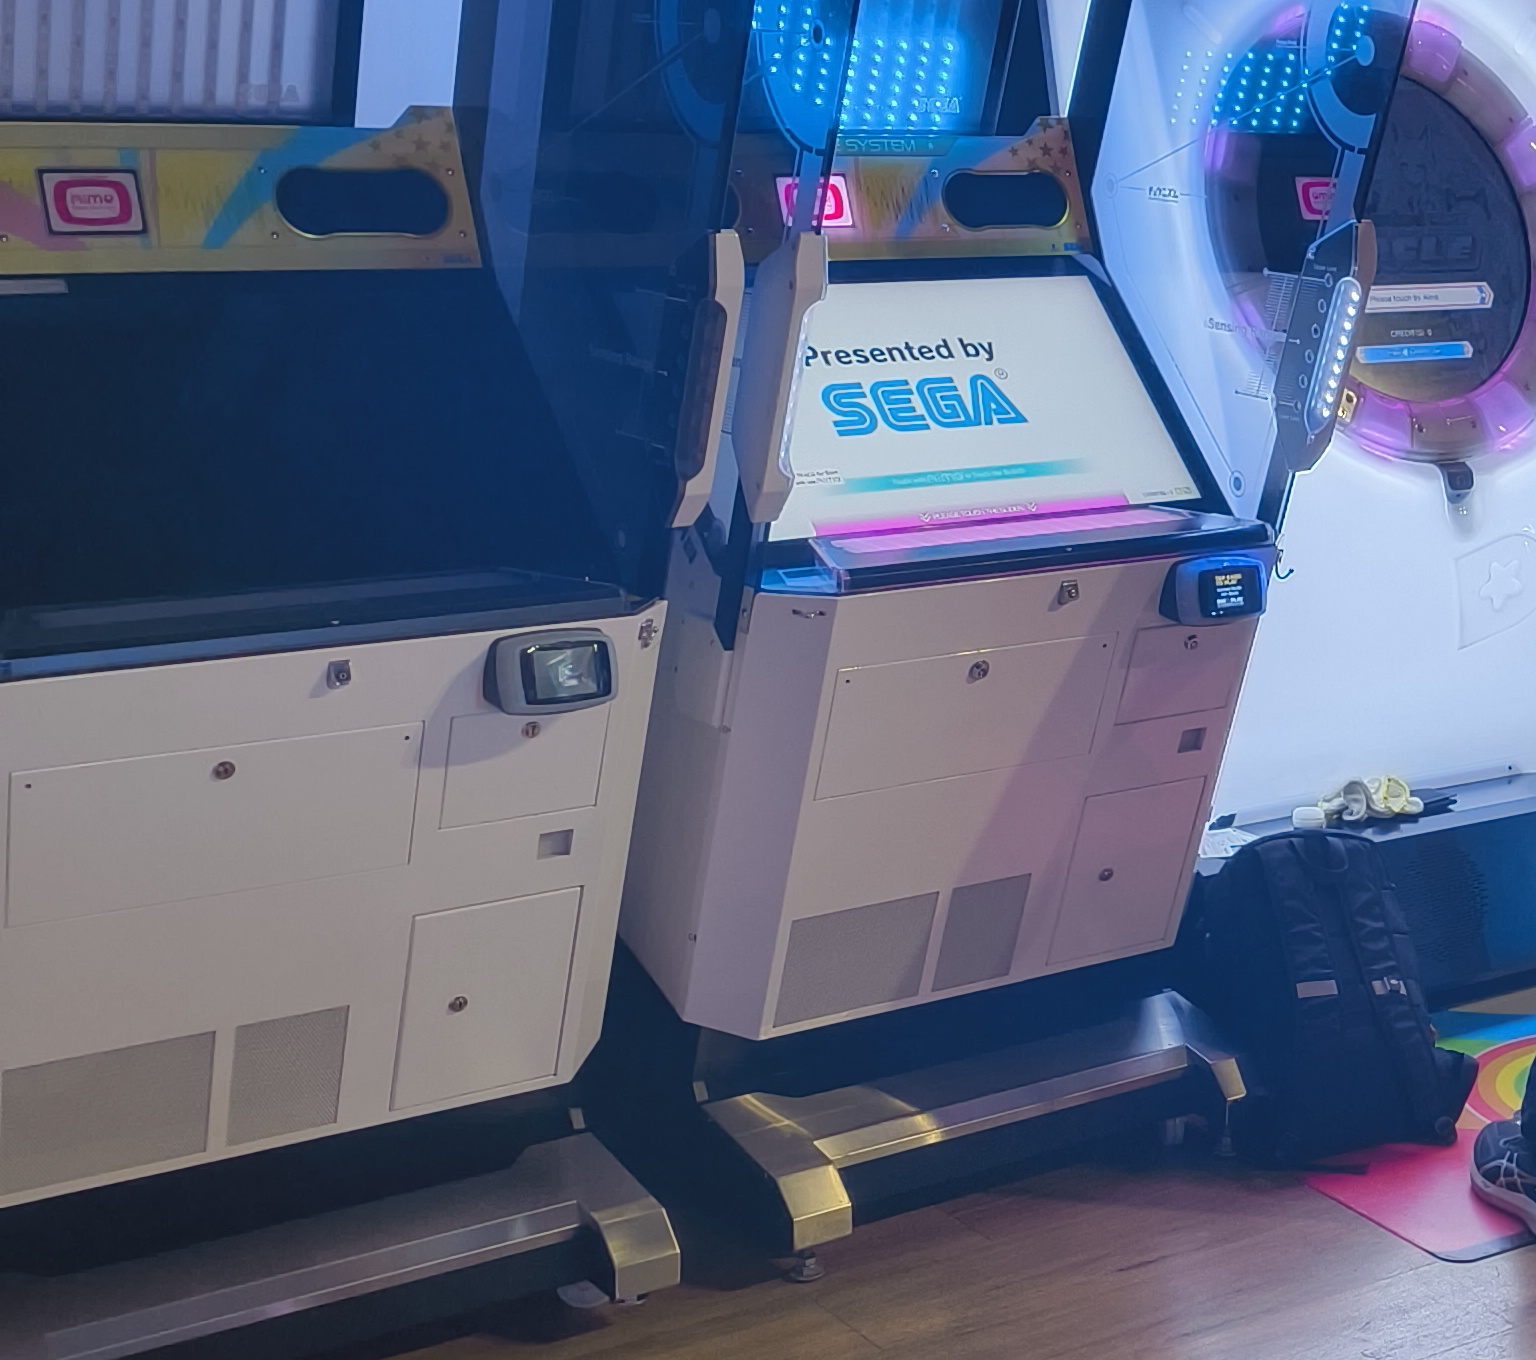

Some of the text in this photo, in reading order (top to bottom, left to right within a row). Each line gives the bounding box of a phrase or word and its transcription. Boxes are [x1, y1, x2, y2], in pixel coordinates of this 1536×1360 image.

[845, 139, 916, 153] SYSTEM
[957, 337, 995, 362] by
[821, 373, 1030, 437] SEGA
